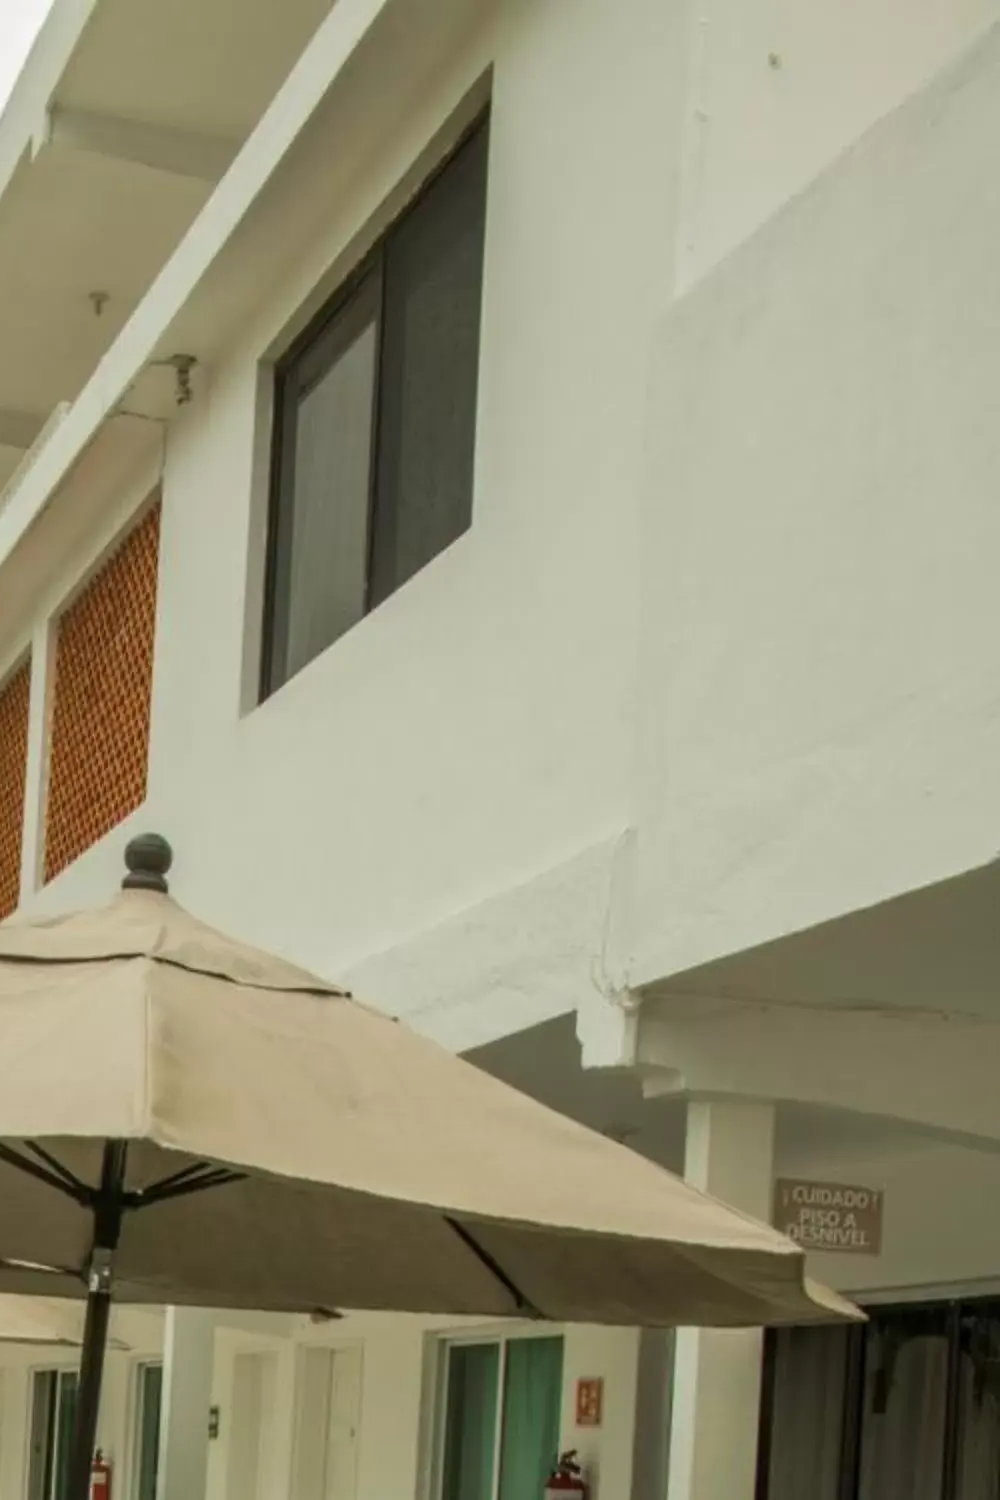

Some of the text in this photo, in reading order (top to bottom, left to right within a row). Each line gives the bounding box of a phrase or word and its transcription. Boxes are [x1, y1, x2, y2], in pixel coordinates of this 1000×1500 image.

[800, 1208, 857, 1229] PISO A
[787, 1223, 871, 1246] DESNIVEL
